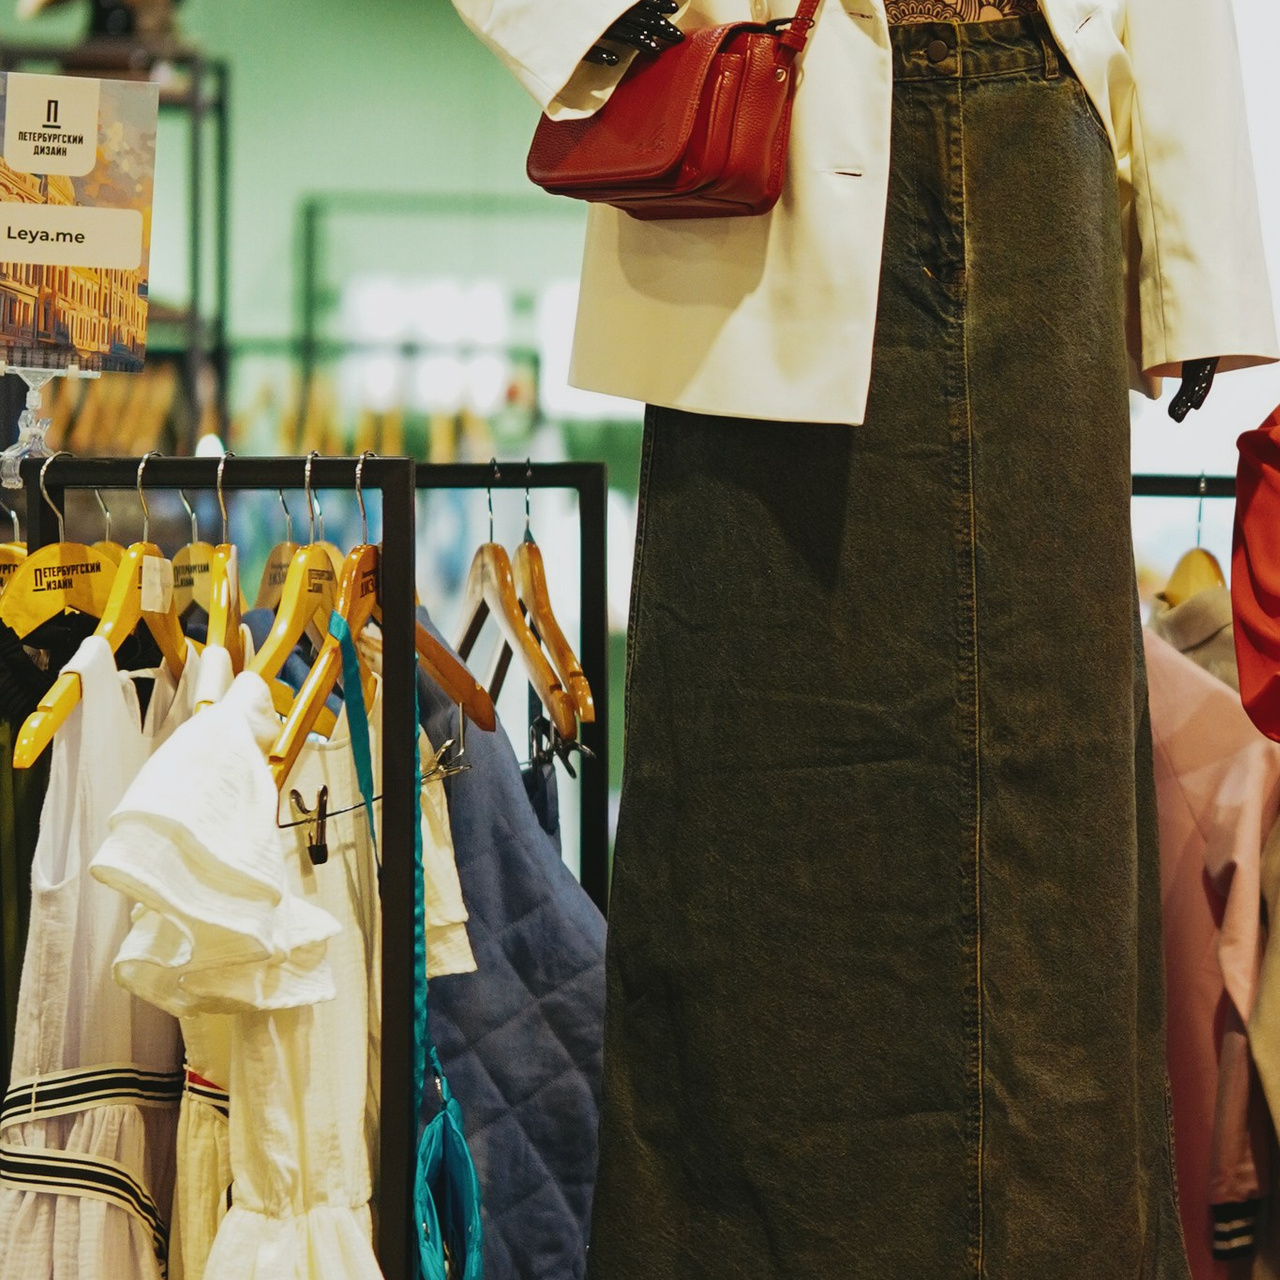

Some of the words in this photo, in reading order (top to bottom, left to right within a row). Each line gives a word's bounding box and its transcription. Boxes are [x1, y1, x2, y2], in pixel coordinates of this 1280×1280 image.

[18, 131, 84, 145] ПЕТЕРБУРГСКИЙ
[33, 145, 67, 156] ДИЗАЙН
[7, 226, 86, 244] Leya.me
